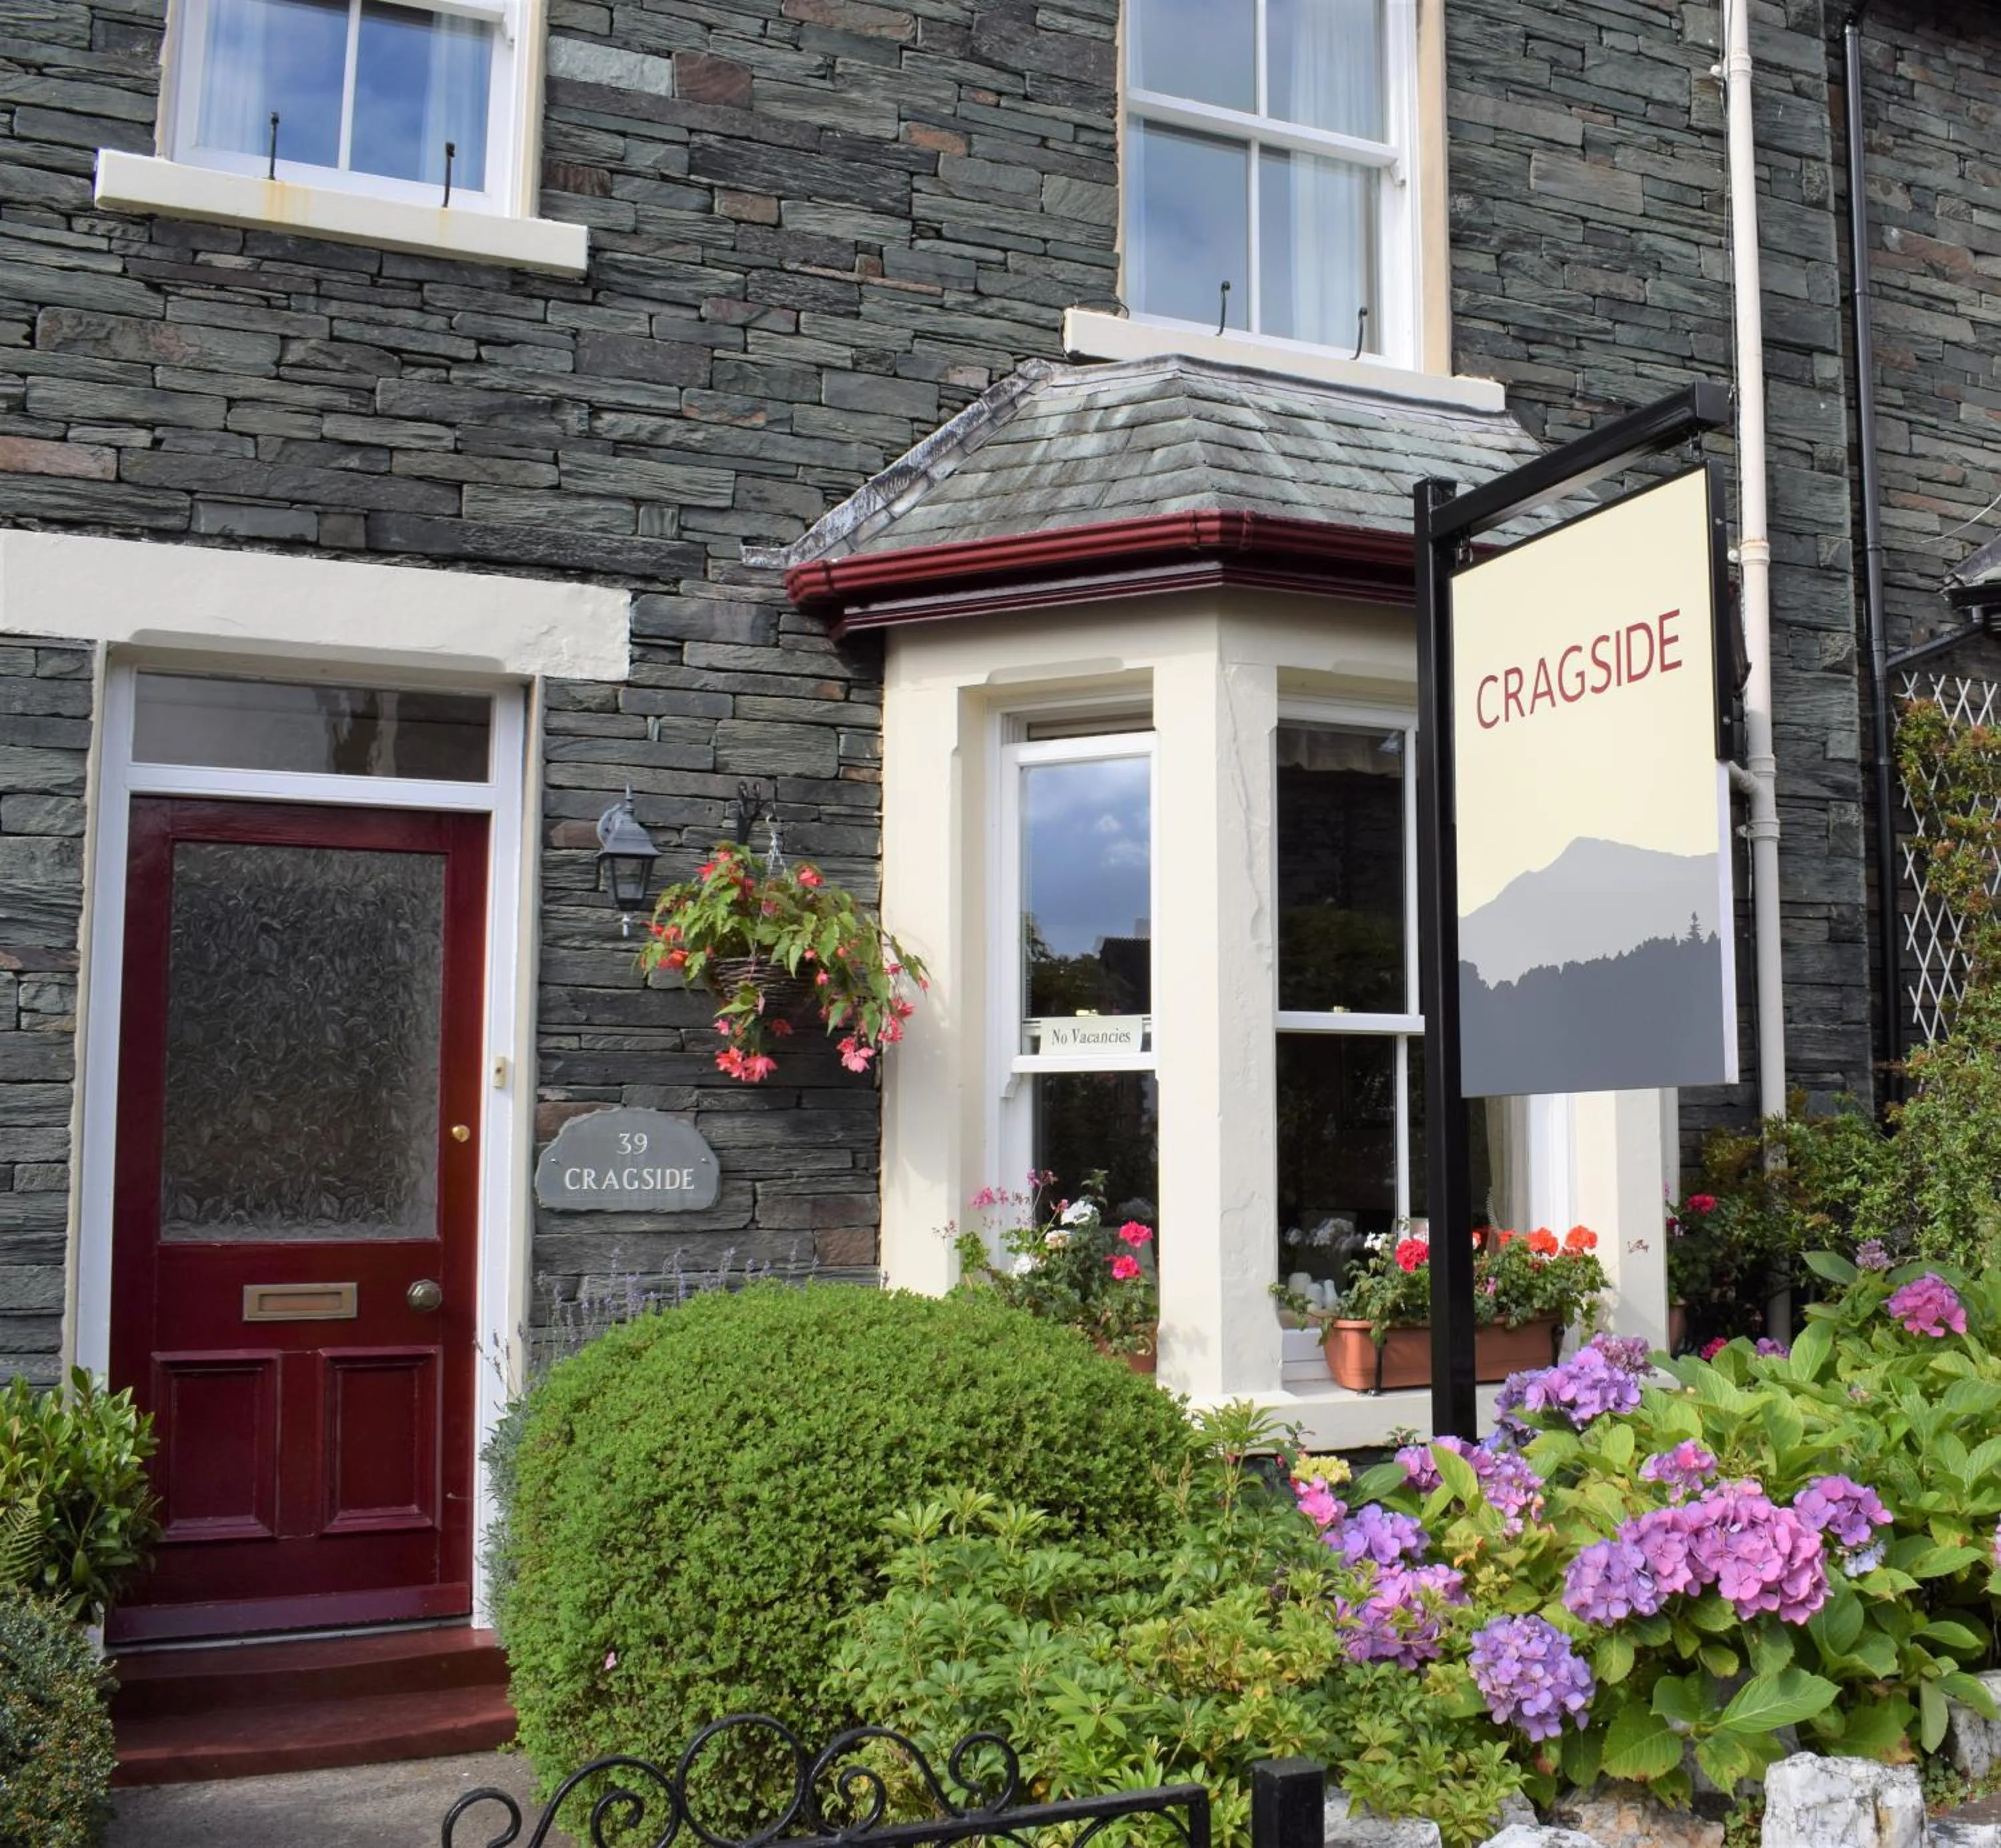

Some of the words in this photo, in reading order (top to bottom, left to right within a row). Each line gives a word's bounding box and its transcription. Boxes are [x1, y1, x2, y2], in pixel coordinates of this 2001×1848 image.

[1476, 608, 1683, 729] CRAGSIDE
[1051, 1028, 1068, 1045] No
[1072, 1027, 1131, 1044] Vacancies
[616, 1132, 648, 1155] 39
[564, 1168, 695, 1190] CRAGSIDE
